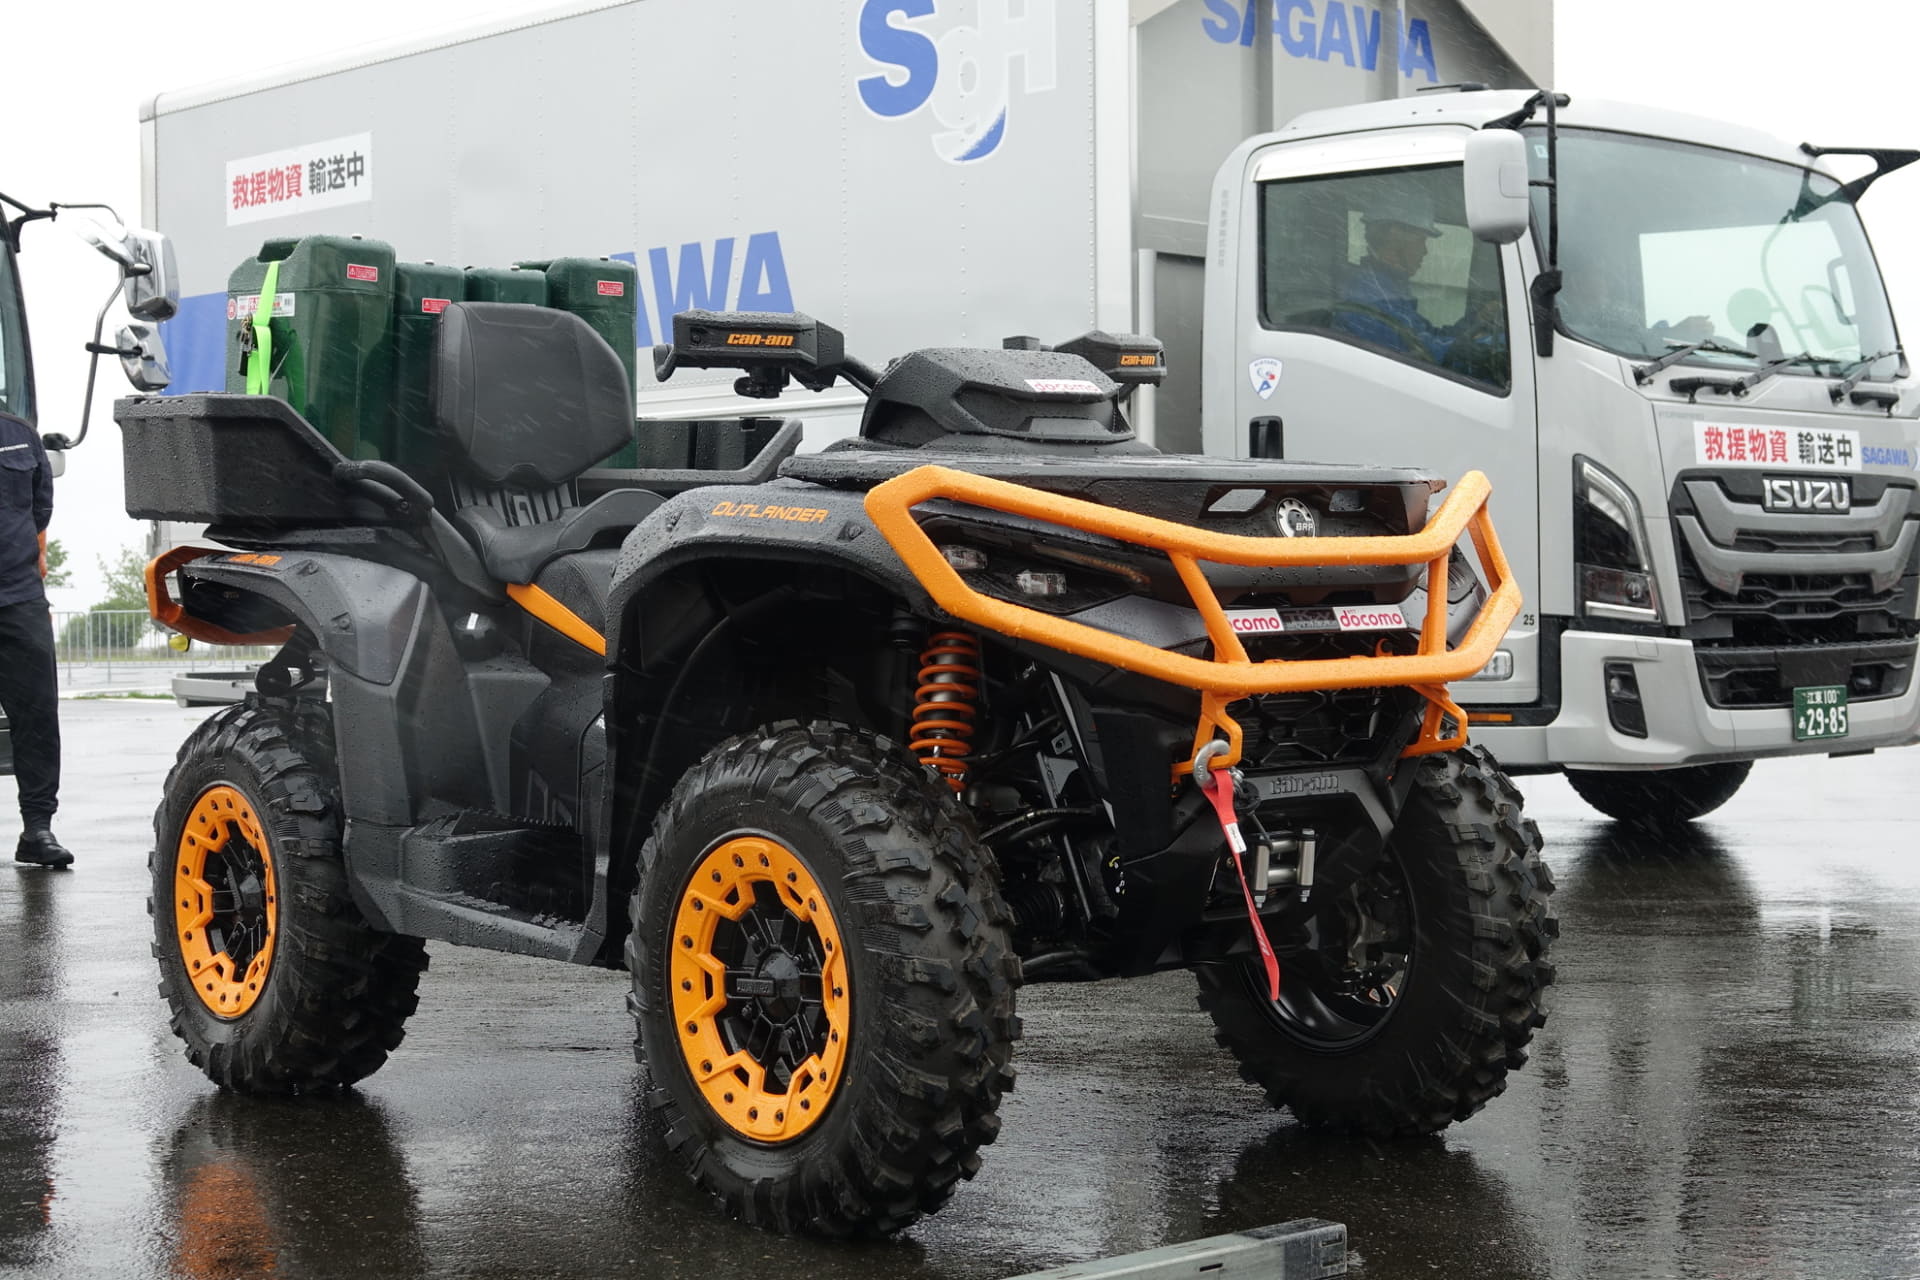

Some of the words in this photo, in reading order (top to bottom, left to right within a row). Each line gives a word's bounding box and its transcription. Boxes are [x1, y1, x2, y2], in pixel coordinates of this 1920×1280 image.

[232, 164, 303, 209] 救援物資
[308, 150, 365, 195] 輸送中
[727, 333, 794, 346] can-am
[1704, 426, 1789, 463] 救援物資
[1797, 431, 1853, 466] 輸送中
[1861, 446, 1909, 466] SAGAWA
[1762, 479, 1850, 510] ISUZU
[1296, 522, 1314, 532] BRP
[1339, 610, 1403, 627] docomo
[1523, 613, 1535, 626] 25
[1806, 706, 1847, 736] 29-85
